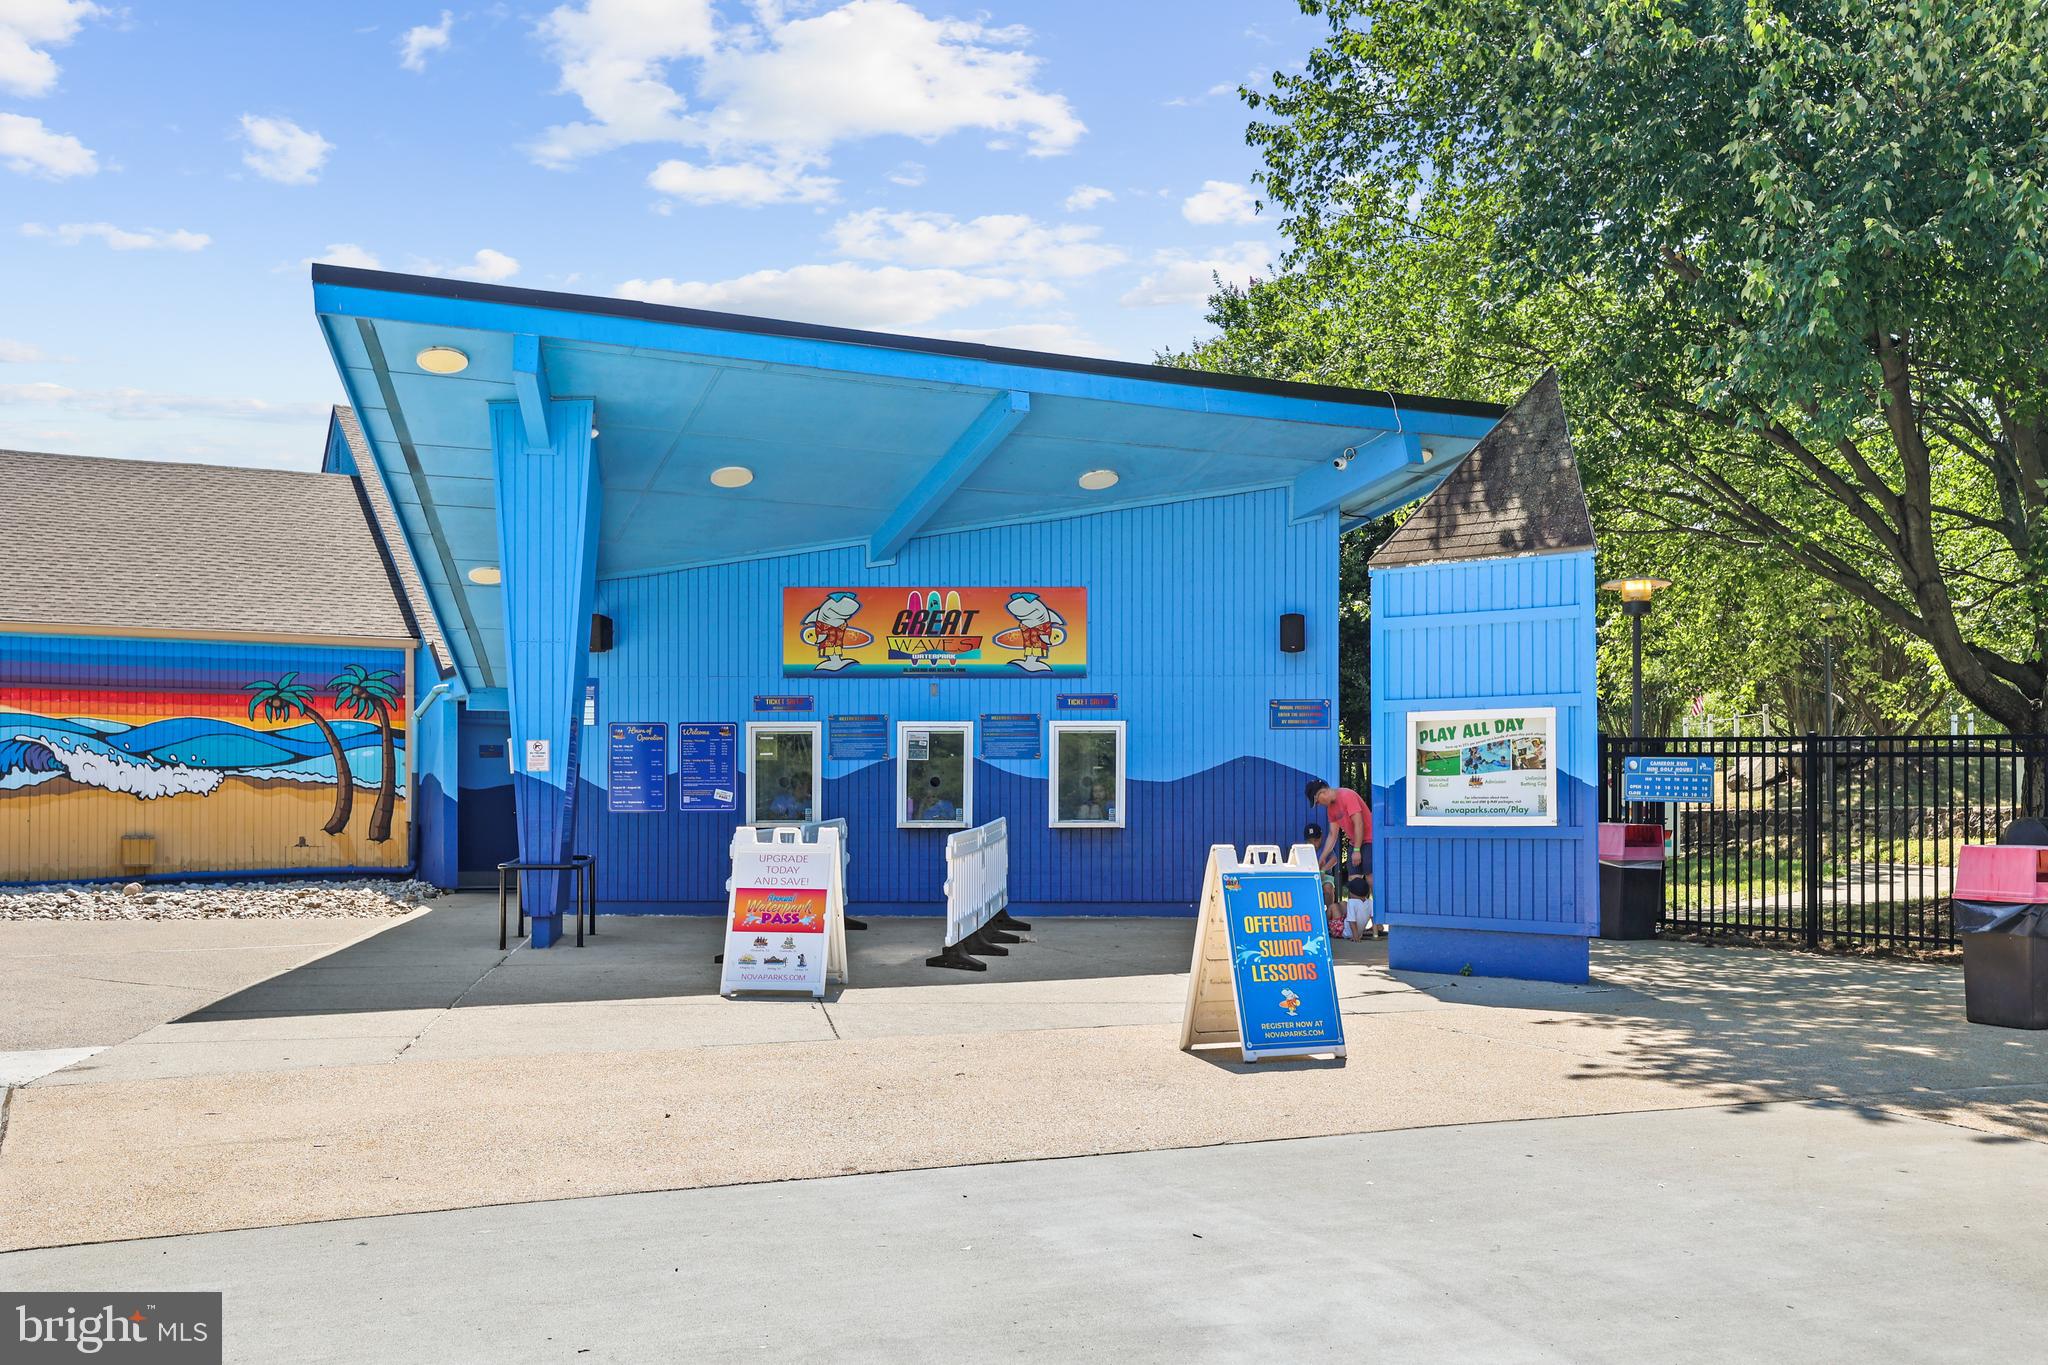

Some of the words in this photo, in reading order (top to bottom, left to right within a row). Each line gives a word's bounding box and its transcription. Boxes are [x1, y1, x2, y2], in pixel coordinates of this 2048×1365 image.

[892, 609, 979, 635] GREAT
[894, 639, 974, 652] WAVES
[682, 728, 710, 736] Welcome
[1419, 726, 1456, 744] PLAY
[1463, 722, 1490, 738] ALL
[1495, 718, 1525, 733] DAY
[1445, 805, 1529, 815] novaparks.com/Play
[759, 854, 808, 863] UPGRADE
[766, 865, 800, 874] TODAY
[754, 877, 778, 885] AND
[780, 877, 809, 886] SAVE!
[767, 894, 797, 902] Annual
[1258, 891, 1292, 909] NOW
[747, 899, 812, 915] Waterpark
[761, 912, 800, 924] PASS
[1244, 915, 1312, 933] OFFERING
[1259, 939, 1304, 957] SWIM
[741, 973, 806, 981] NOVAPARKS.COM
[1251, 962, 1318, 982] LESSONS
[1265, 1029, 1324, 1038] NOVAPARKS.COM
